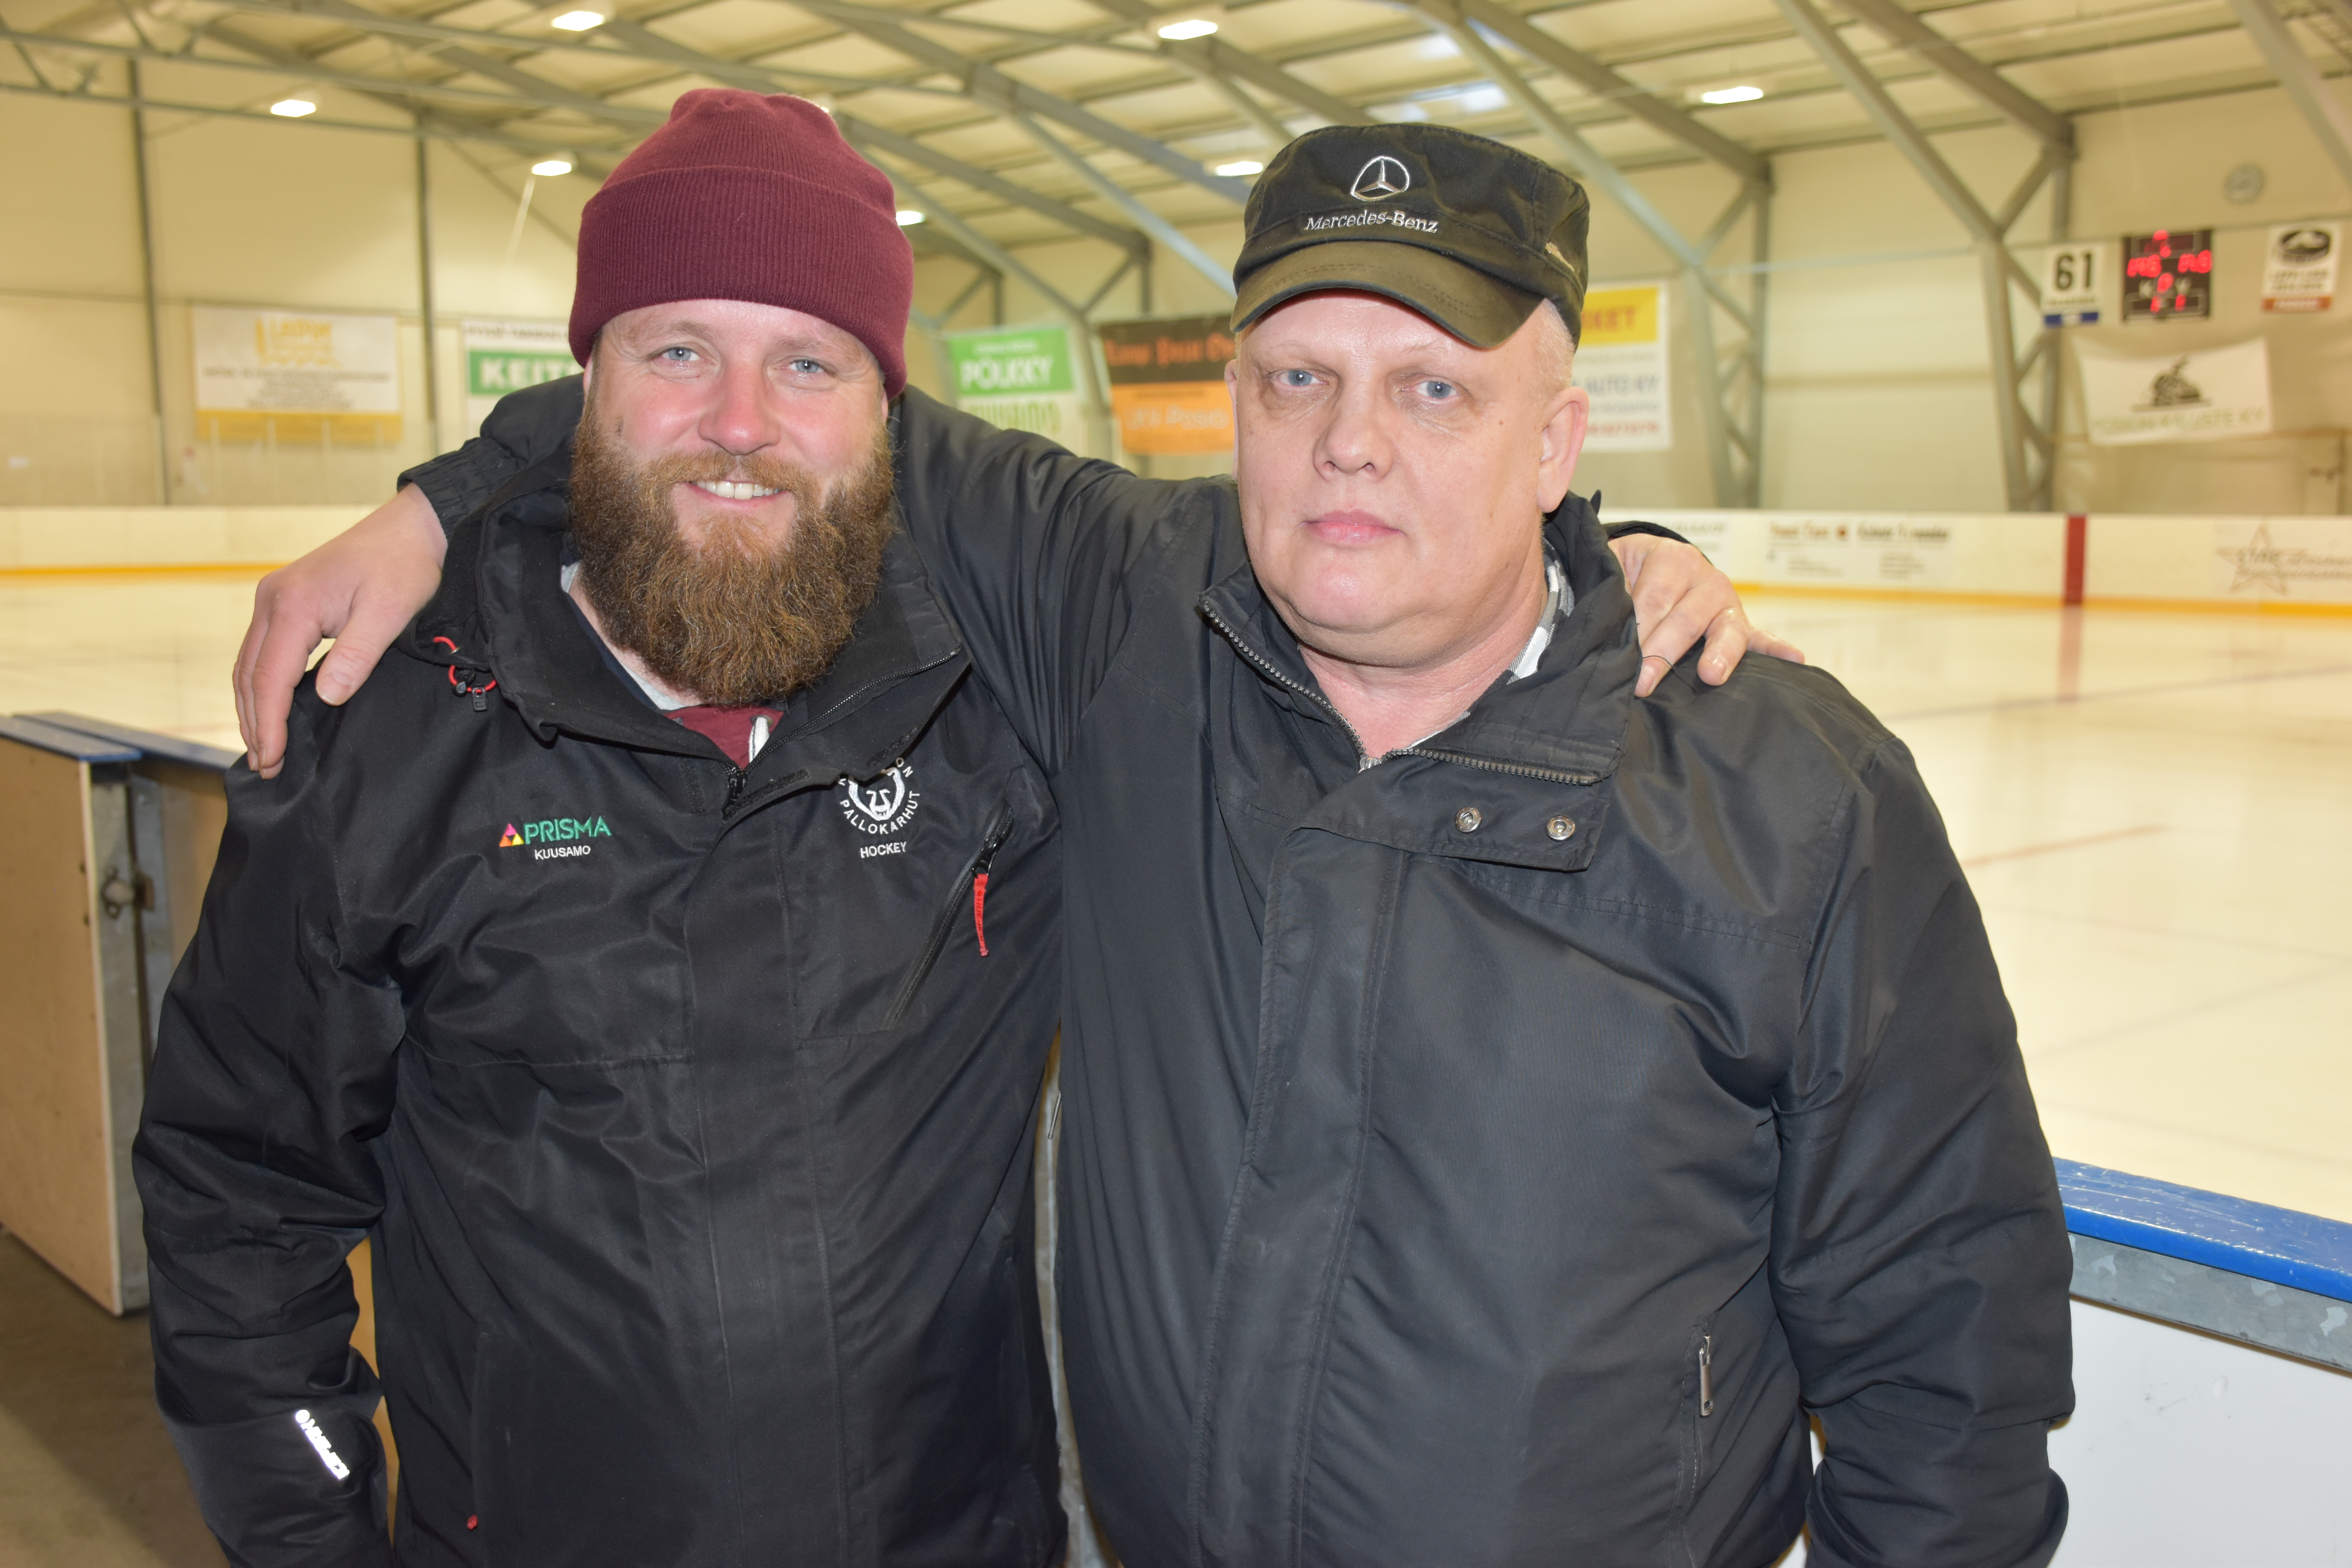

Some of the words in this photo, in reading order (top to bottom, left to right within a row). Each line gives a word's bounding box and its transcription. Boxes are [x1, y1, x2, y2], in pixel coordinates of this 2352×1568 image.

[1303, 209, 1439, 234] Mercedes-Benz
[2056, 253, 2092, 290] 61
[840, 790, 920, 835] PALLOKARHUT
[523, 815, 612, 844] PRISMA
[534, 845, 591, 860] KUUSAMO
[860, 841, 907, 858] HOCKEY
